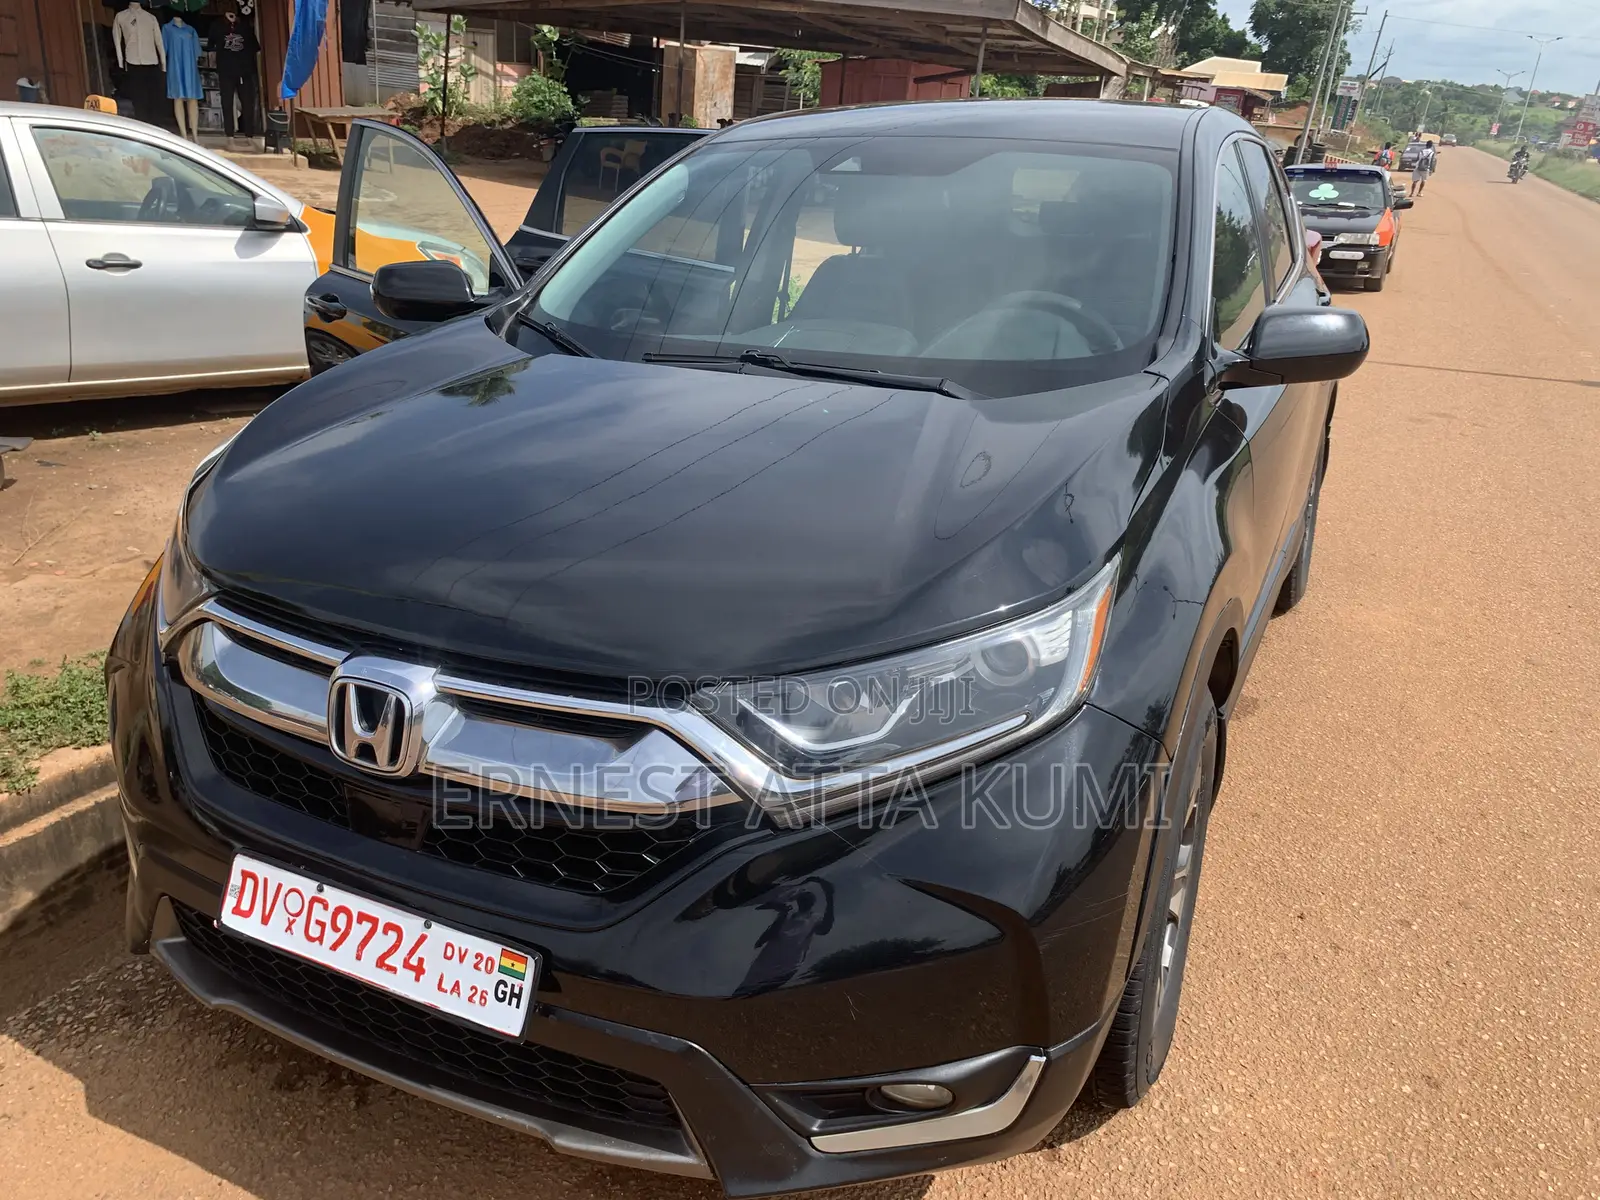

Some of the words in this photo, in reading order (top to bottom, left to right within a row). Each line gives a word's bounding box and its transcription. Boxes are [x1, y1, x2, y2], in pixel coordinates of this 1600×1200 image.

[85, 99, 100, 110] TAXI
[303, 895, 429, 983] G9724
[442, 941, 470, 965] DV
[473, 951, 496, 975] 20
[436, 972, 462, 999] LA
[467, 984, 489, 1008] 26
[494, 979, 524, 1010] GH
